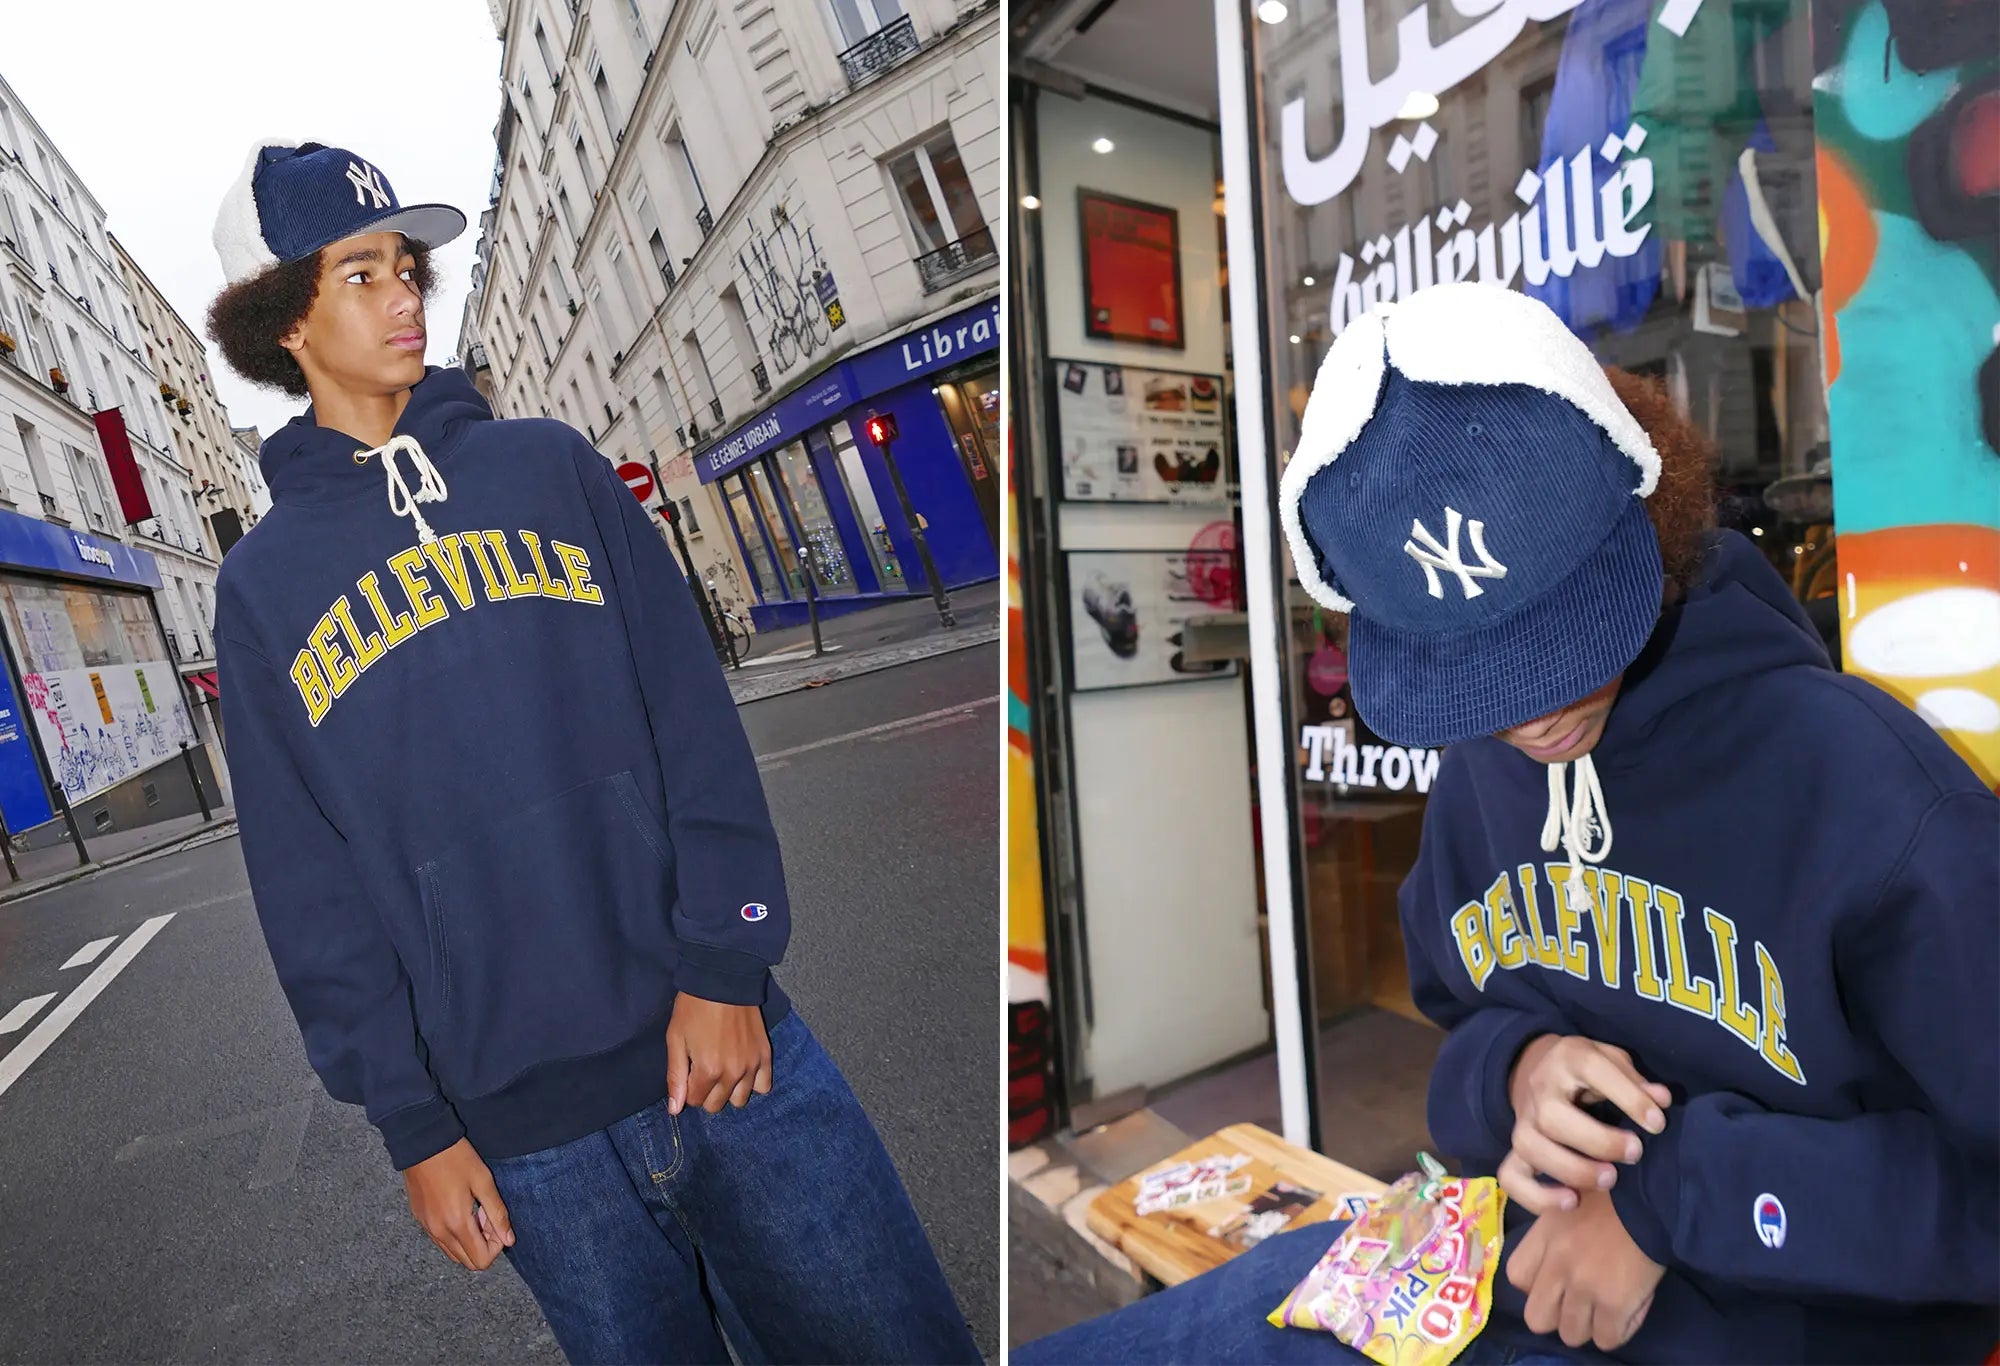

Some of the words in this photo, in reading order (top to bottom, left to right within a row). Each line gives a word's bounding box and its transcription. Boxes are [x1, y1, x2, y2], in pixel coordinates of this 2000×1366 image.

[345, 161, 391, 209] NY
[718, 438, 747, 466] GENRE
[1404, 506, 1509, 600] NY
[289, 529, 605, 727] BELLEVILLE
